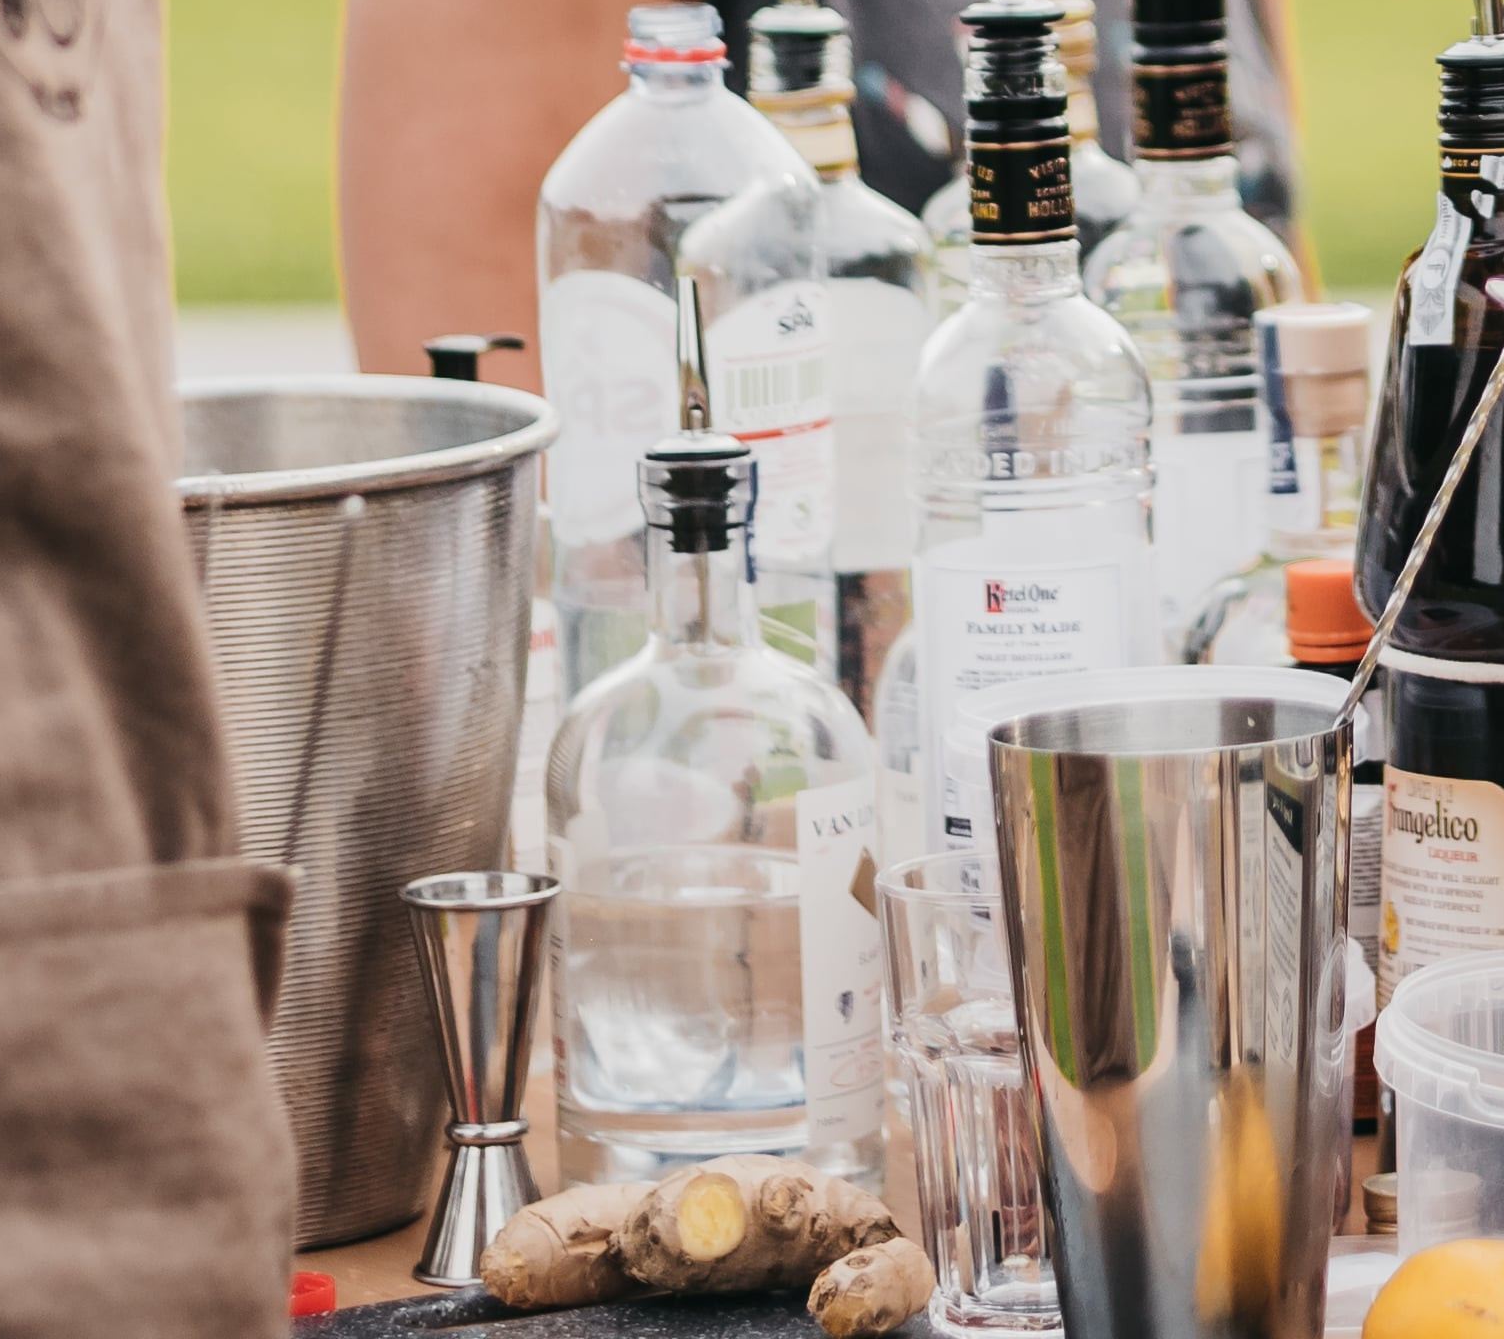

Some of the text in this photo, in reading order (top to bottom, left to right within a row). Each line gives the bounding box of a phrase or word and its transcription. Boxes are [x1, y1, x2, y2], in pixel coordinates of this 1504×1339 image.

[985, 580, 1058, 612] Ketel One
[966, 621, 1082, 635] FAMILY MADE
[812, 813, 854, 837] VAN
[1428, 846, 1480, 863] LIQUEUR
[1462, 874, 1500, 885] DELIGHT
